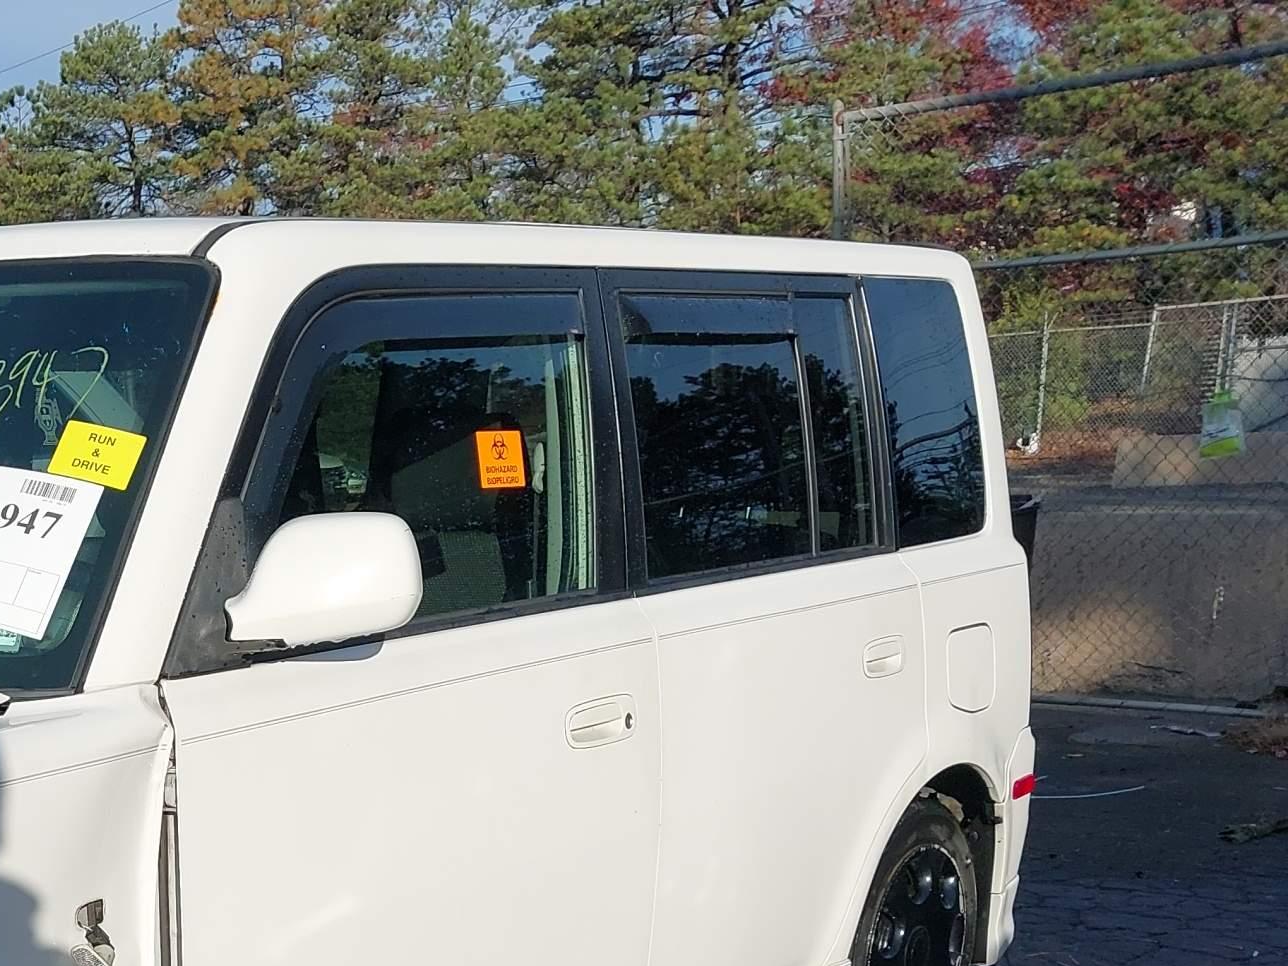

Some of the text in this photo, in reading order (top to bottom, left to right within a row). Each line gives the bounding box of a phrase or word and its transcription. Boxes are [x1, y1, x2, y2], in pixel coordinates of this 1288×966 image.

[88, 432, 117, 447] RUN
[91, 447, 101, 458] &
[71, 457, 112, 475] DRIVE
[485, 465, 518, 474] BIOHAZARD
[486, 476, 520, 485] BIOPELIGRO
